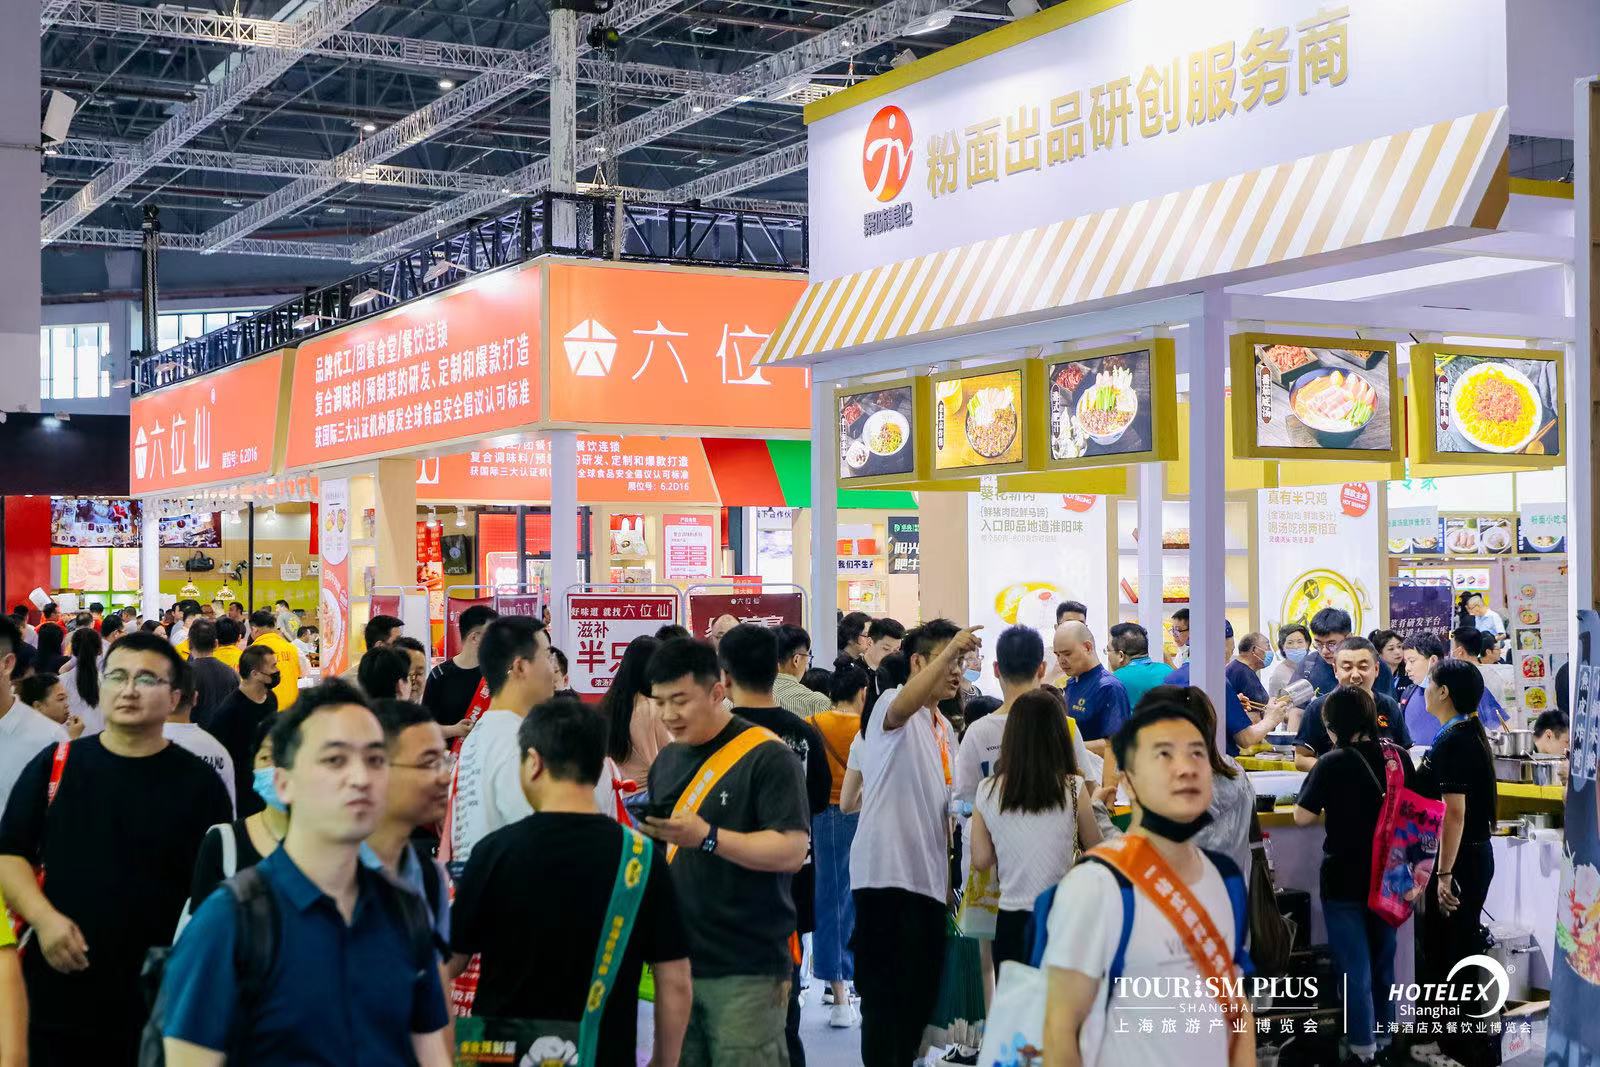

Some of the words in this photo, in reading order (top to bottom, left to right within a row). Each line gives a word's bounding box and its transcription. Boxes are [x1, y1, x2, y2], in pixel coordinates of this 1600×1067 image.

[926, 6, 1351, 199] 粉面出品研创服务商
[315, 320, 448, 384] 品牌代工/团餐食堂/餐饮连锁
[315, 332, 529, 417] 复合调味料/预制菜的研发、定制和爆款打造
[632, 320, 808, 388] 六位
[150, 406, 210, 480] 六位仙
[315, 378, 530, 448] 获国际三大认证机构颁发全球食品安全倡议认可标准
[981, 520, 1084, 533] 入口即品地道淮阳味
[1267, 490, 1328, 505] 真有半只鸡
[1268, 522, 1337, 534] 喝汤吃肉两相宜
[577, 621, 609, 638] 滋补
